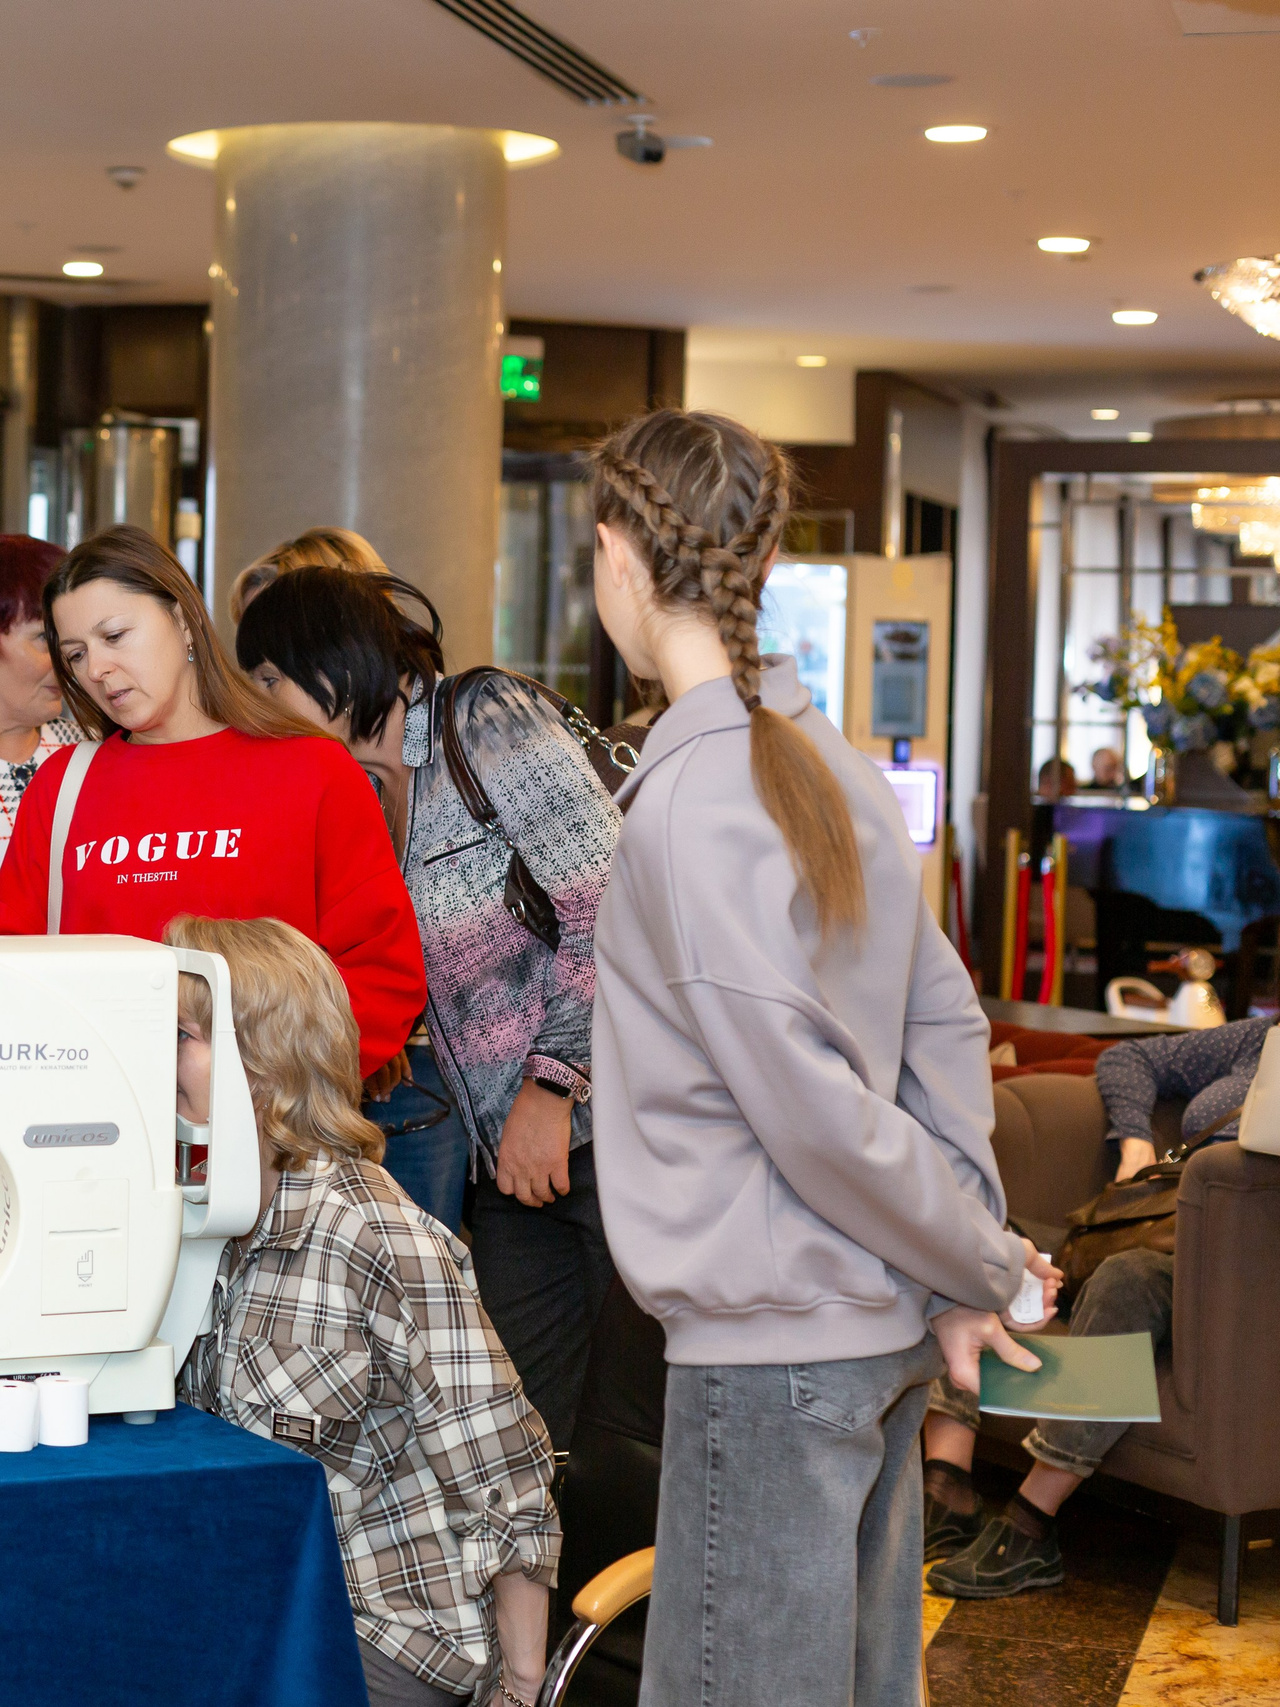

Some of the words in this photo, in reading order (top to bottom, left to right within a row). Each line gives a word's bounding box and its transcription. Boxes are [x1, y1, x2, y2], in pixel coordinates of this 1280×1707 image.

[75, 829, 241, 871] VOGUE
[116, 874, 129, 884] IN
[132, 871, 178, 883] THE87TH
[0, 1043, 89, 1061] URK-700
[32, 1128, 110, 1144] unicos
